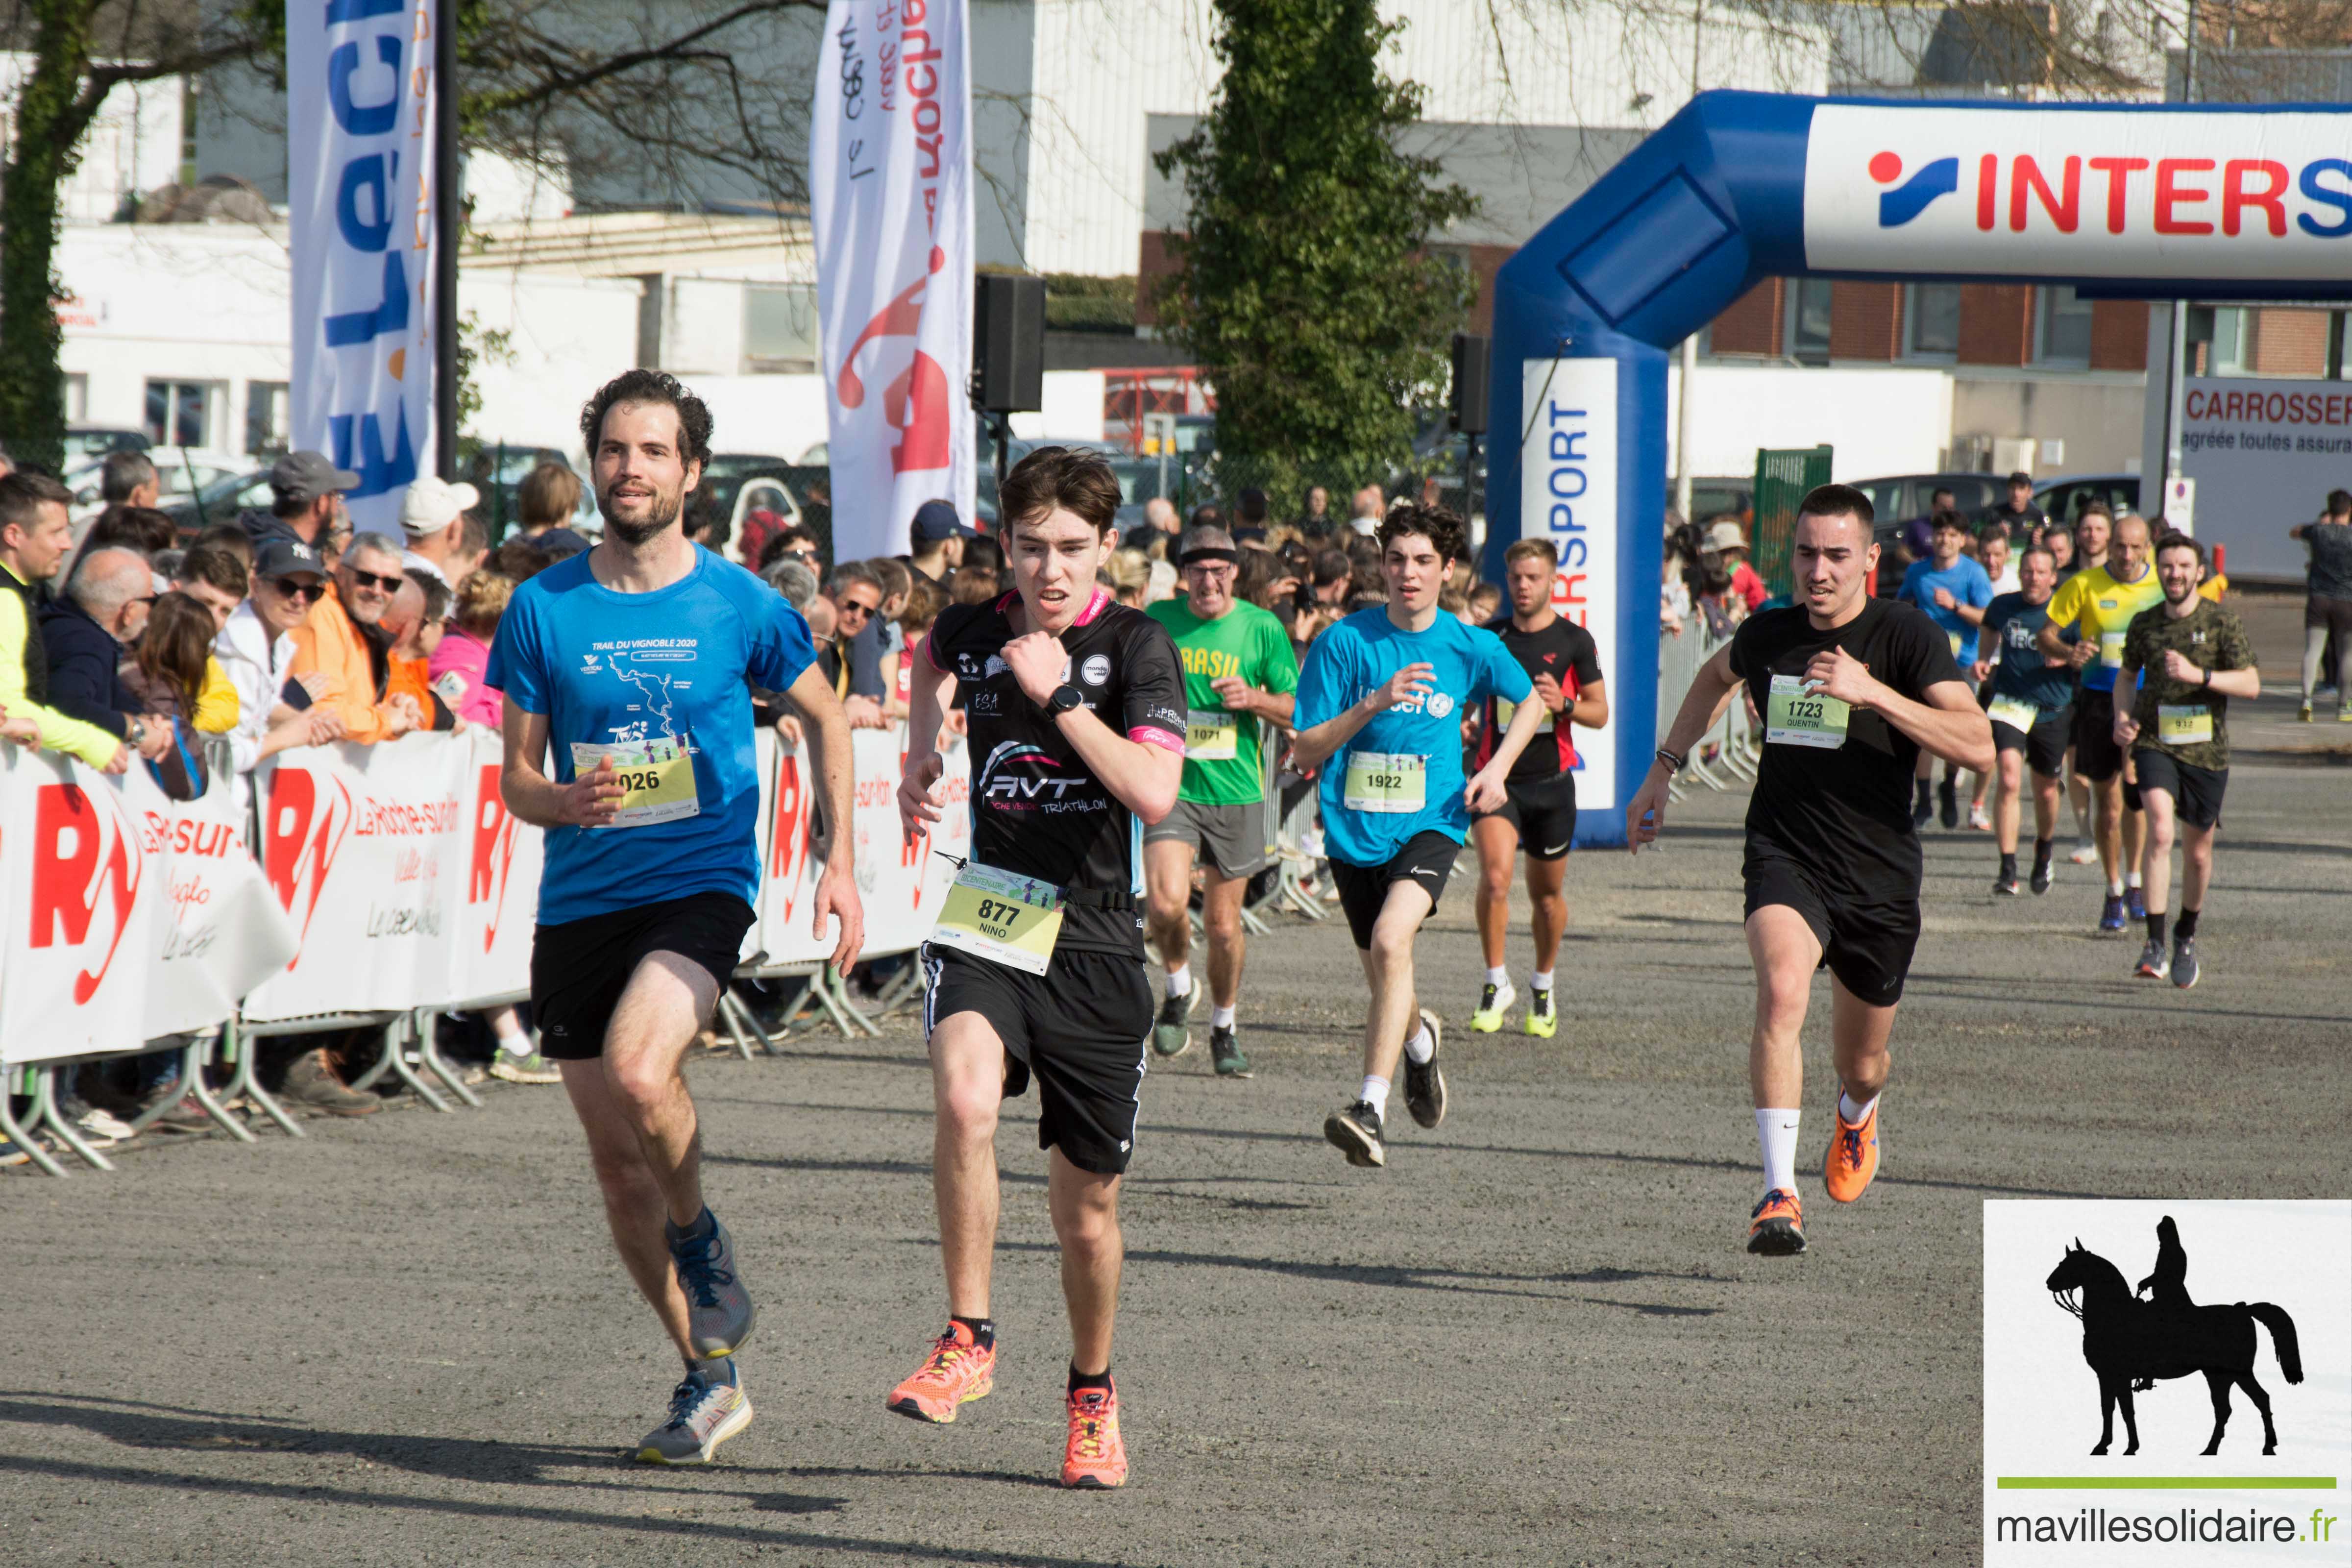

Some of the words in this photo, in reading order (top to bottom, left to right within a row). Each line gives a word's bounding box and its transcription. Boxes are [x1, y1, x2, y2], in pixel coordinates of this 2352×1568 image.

[2240, 431, 2291, 450] toutes
[592, 642, 614, 651] TRAIL
[616, 640, 631, 649] DU
[632, 638, 675, 648] VIGNOBLE
[676, 638, 697, 647] 2020
[1788, 701, 1823, 719] 1723
[1787, 719, 1819, 729] QUENTIN
[1194, 729, 1220, 740] 1071
[619, 771, 660, 792] 026
[1367, 774, 1401, 788] 1922
[1041, 798, 1107, 814] TRIATHLON
[961, 874, 1007, 891] BICENTENAIRE
[978, 899, 1020, 927] 877
[979, 923, 1007, 938] NINO
